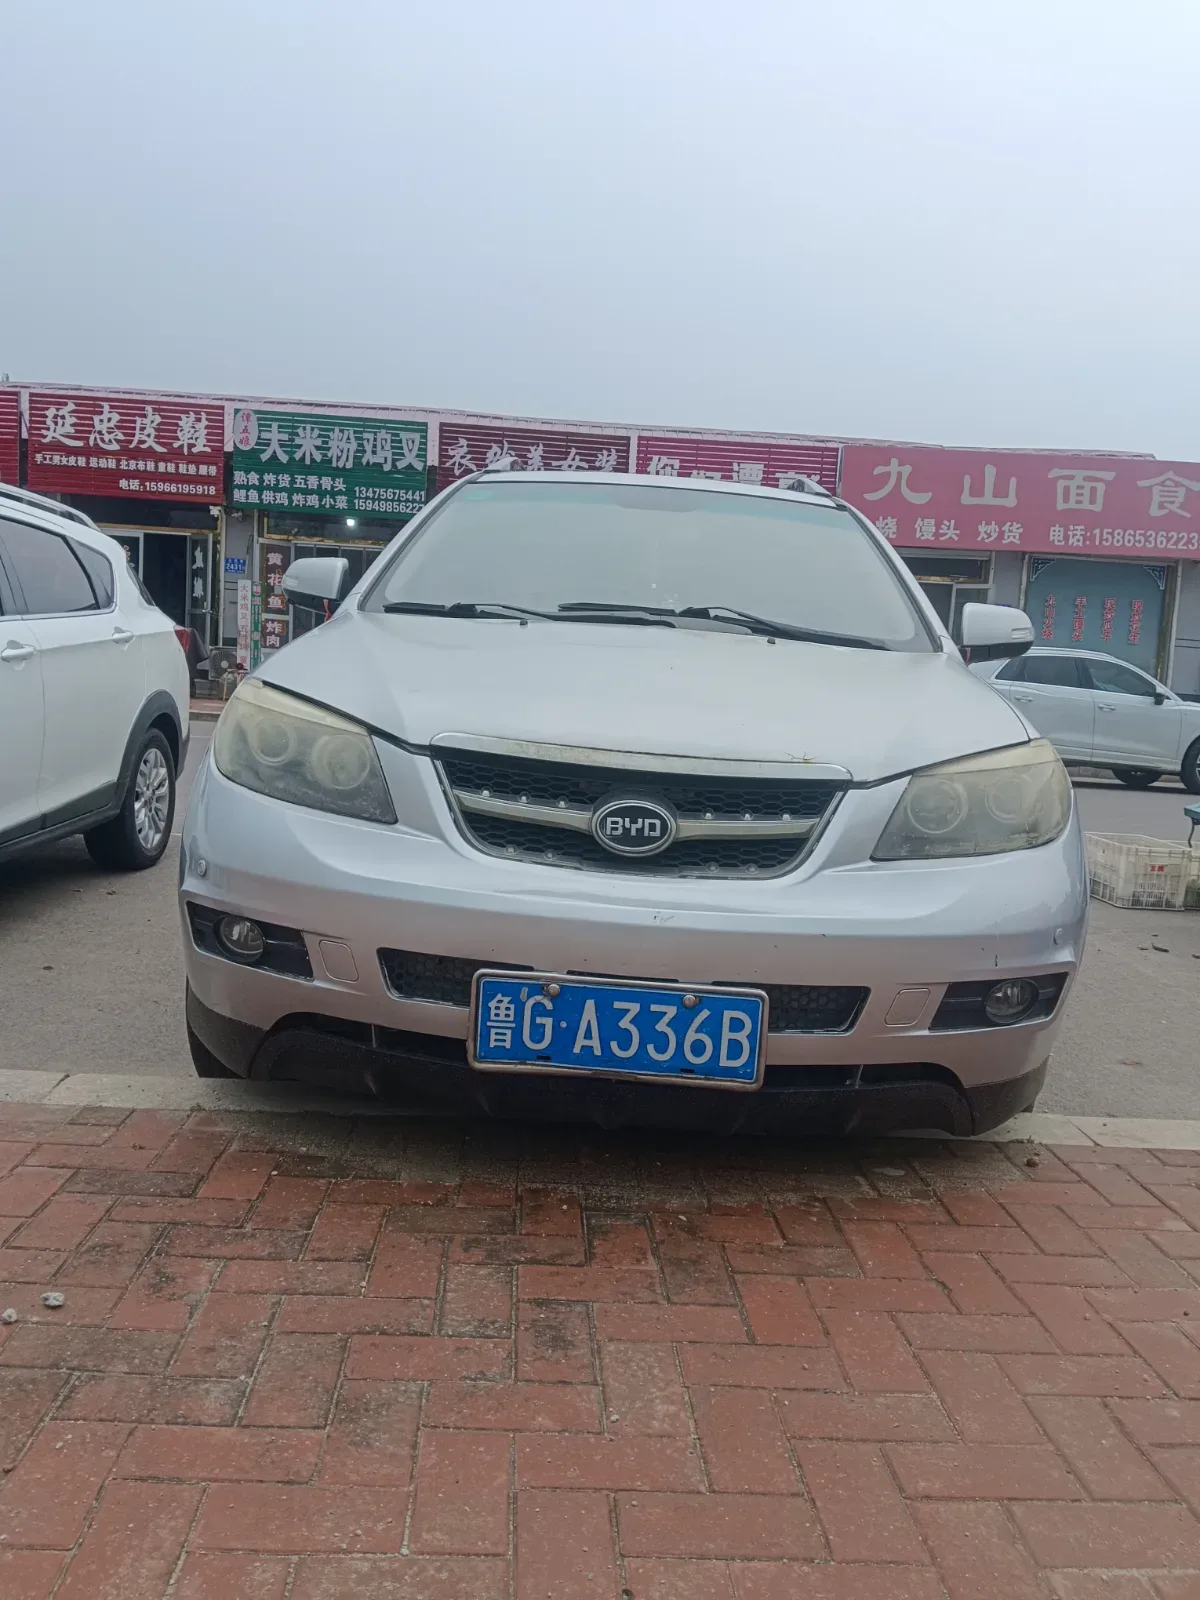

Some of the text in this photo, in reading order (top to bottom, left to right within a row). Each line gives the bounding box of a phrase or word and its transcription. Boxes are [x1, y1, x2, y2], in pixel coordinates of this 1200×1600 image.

[40, 401, 212, 456] 延忠皮鞋
[259, 421, 426, 472] 大米粉鸡叉
[35, 453, 87, 468] 手工男女皮鞋
[89, 457, 117, 470] 运动鞋
[119, 459, 155, 472] 北京布鞋
[233, 471, 347, 492] 熟食 炸货 五香骨头
[863, 457, 1200, 519] 九山面食
[292, 493, 320, 509] 炸鸡
[321, 495, 348, 510] 小菜
[354, 486, 425, 501] 13475675441
[914, 518, 961, 541] 馒头
[976, 520, 1024, 544] 炒货
[265, 620, 283, 648] 炸肉
[606, 817, 661, 837] BYD
